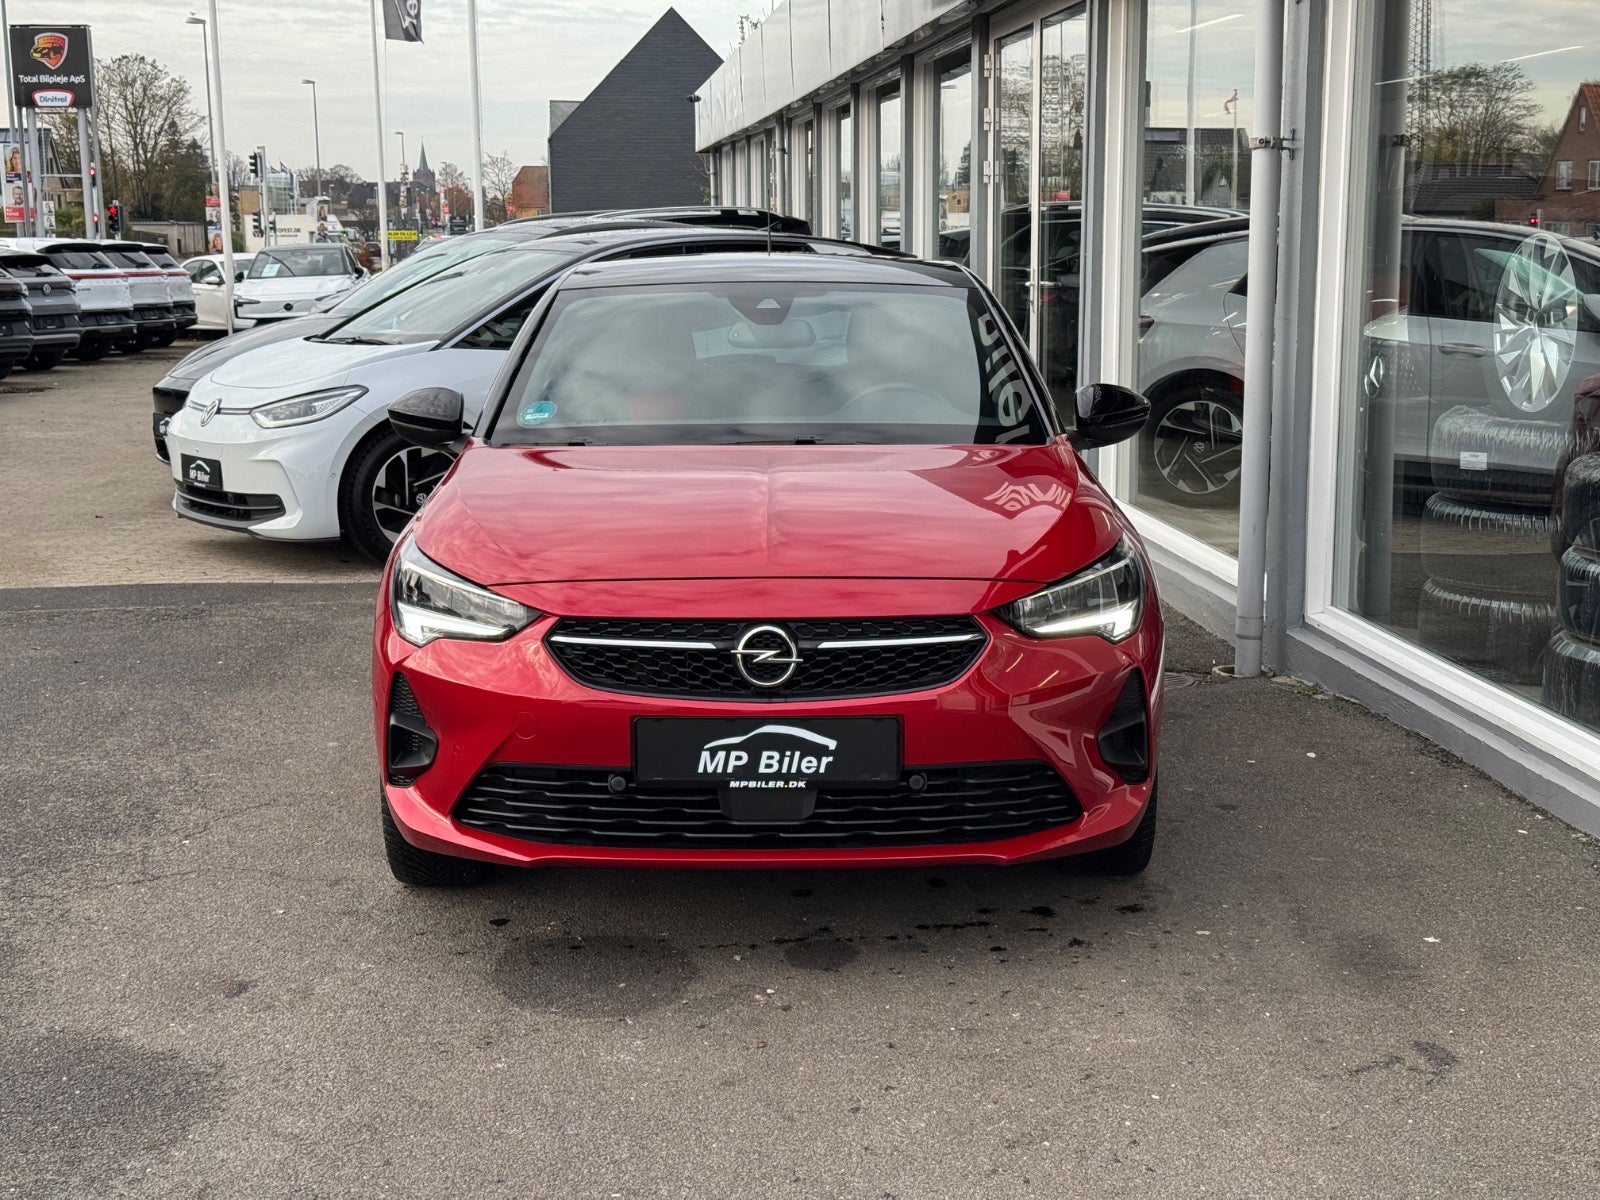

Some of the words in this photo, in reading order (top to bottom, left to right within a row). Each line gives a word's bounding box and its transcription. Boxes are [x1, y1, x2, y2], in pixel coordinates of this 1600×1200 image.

[18, 75, 38, 83] Total
[39, 75, 69, 84] Bilpleje
[70, 75, 86, 84] ApS
[697, 750, 748, 774] MP
[758, 750, 833, 774] Biler
[729, 780, 807, 788] MPBILER.DK
